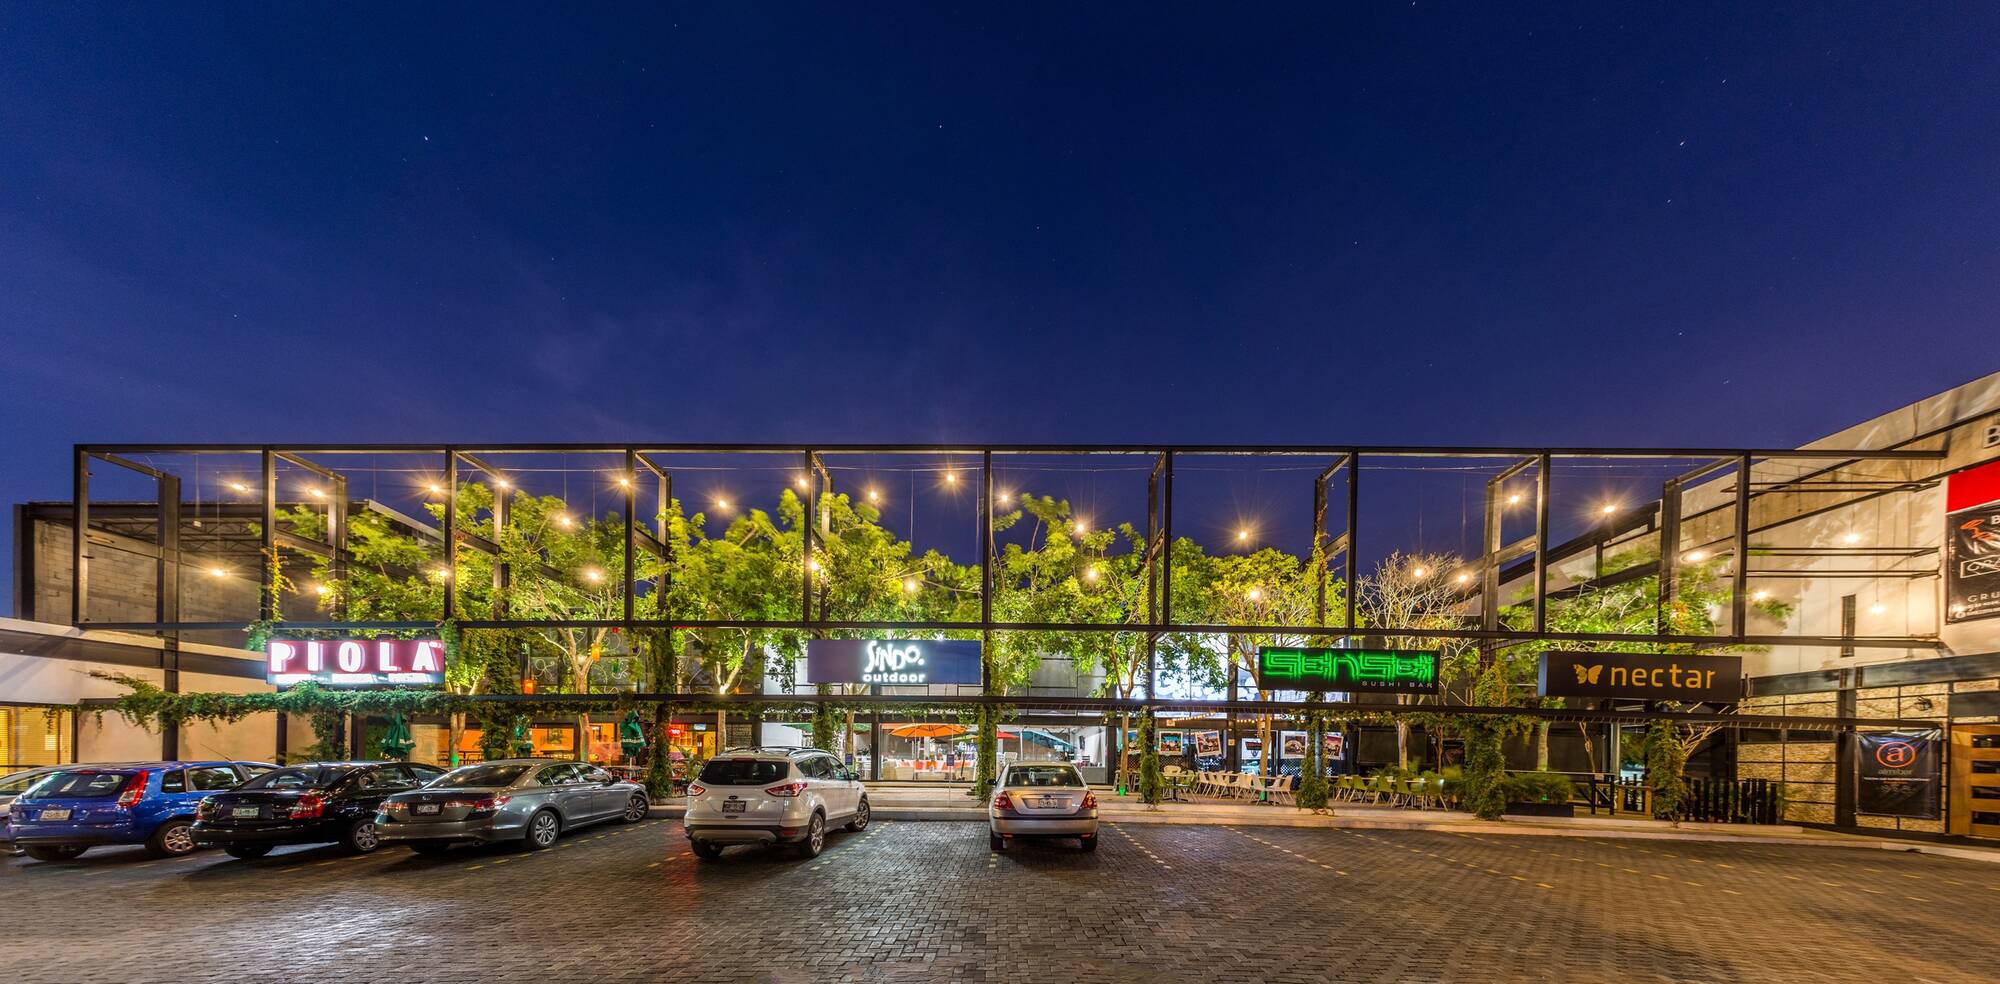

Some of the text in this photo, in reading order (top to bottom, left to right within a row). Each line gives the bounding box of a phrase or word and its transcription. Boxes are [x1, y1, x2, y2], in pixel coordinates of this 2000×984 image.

[270, 641, 437, 673] PIOLA
[862, 672, 926, 683] outdoor
[1361, 680, 1433, 689] SUSHI BAR
[1610, 663, 1716, 689] nectar
